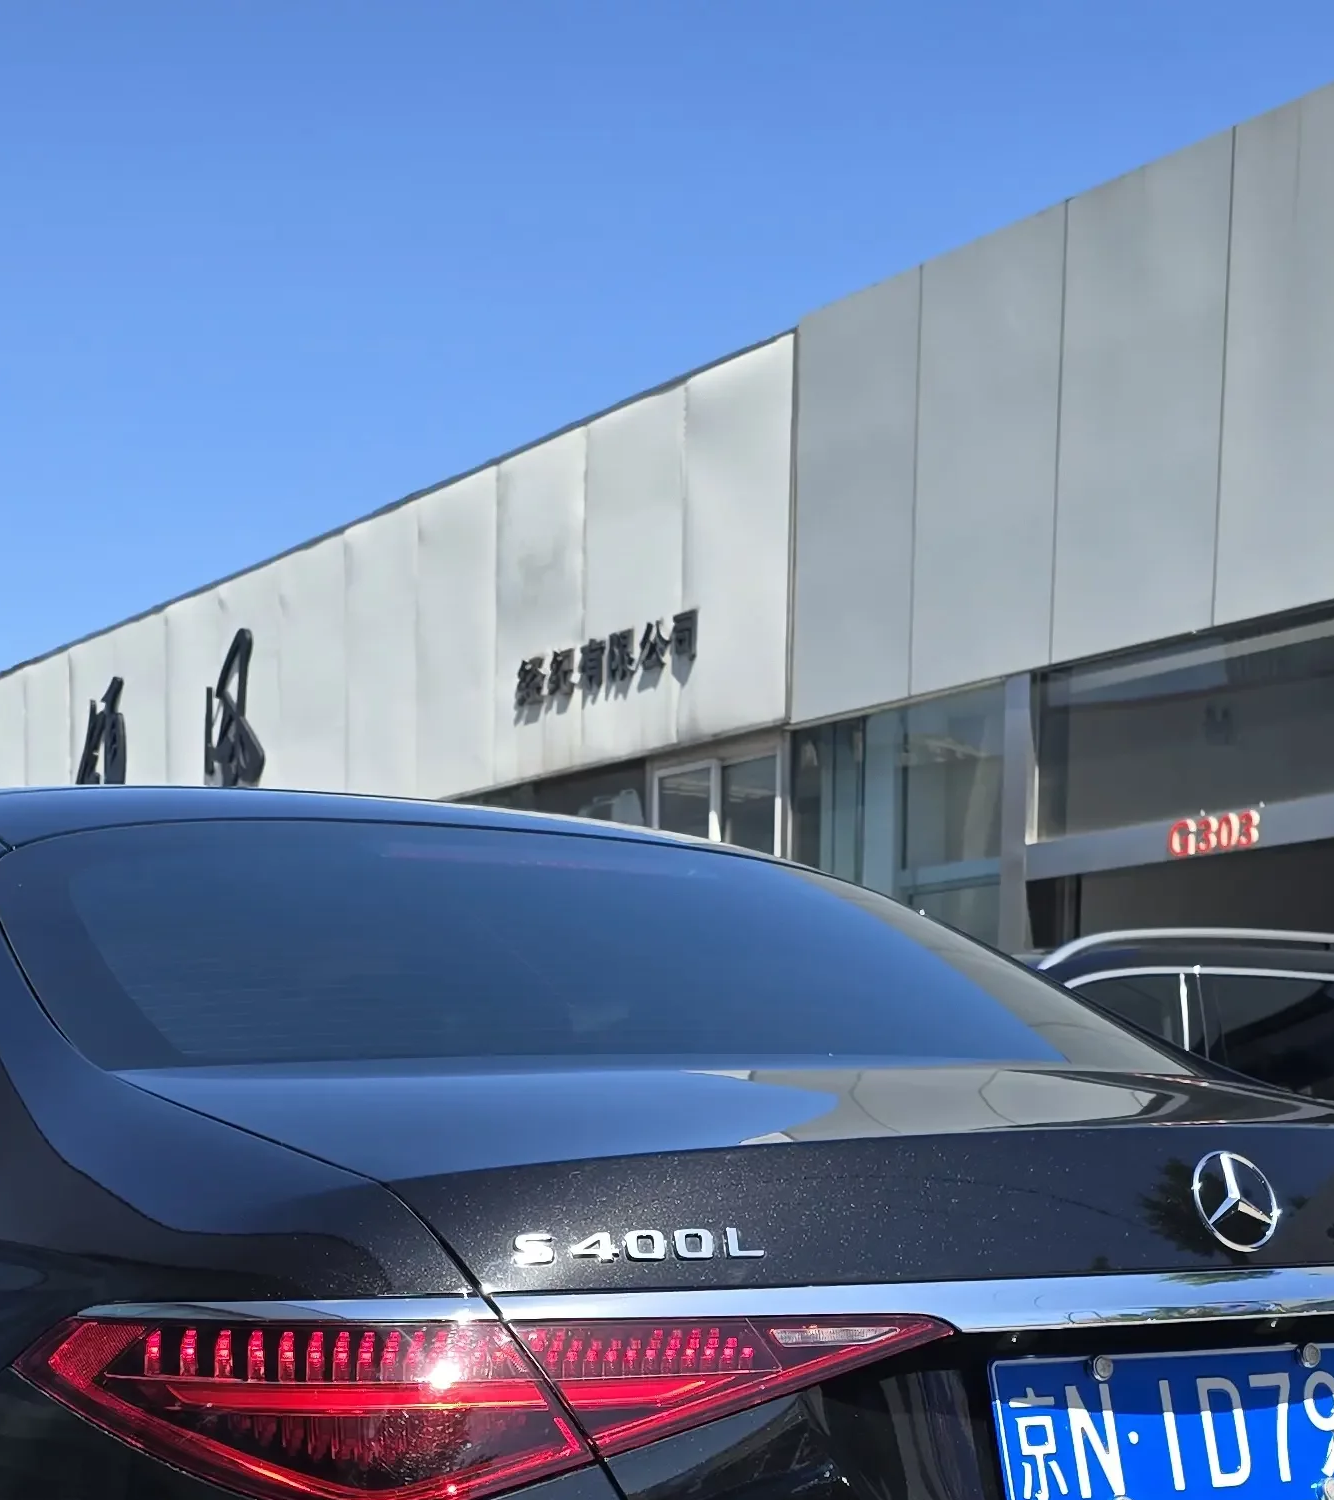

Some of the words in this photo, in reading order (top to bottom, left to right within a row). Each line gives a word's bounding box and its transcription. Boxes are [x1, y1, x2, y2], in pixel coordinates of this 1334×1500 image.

[1170, 809, 1260, 858] G303
[512, 1232, 556, 1266] S
[569, 1227, 766, 1264] 400L
